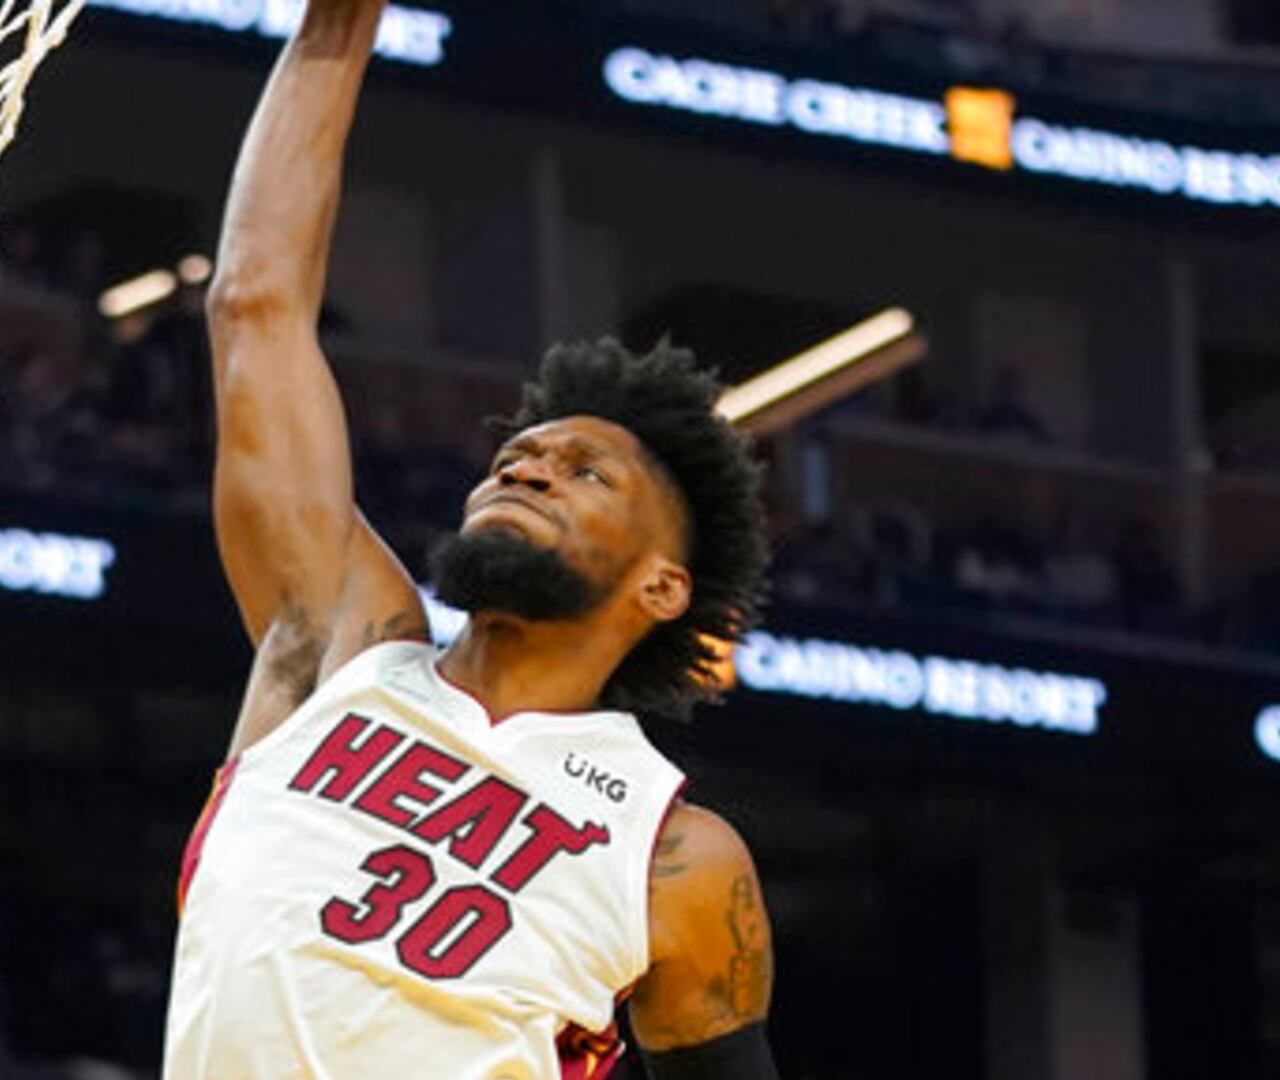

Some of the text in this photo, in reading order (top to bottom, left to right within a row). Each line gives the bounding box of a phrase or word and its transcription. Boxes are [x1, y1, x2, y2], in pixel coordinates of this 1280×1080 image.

[604, 47, 786, 125] CACHE
[787, 79, 947, 152] CREEK
[1011, 119, 1181, 194] CASINO
[733, 630, 1107, 734] CASINO RESORT
[288, 711, 611, 895] HEAT
[320, 844, 513, 980] 30
